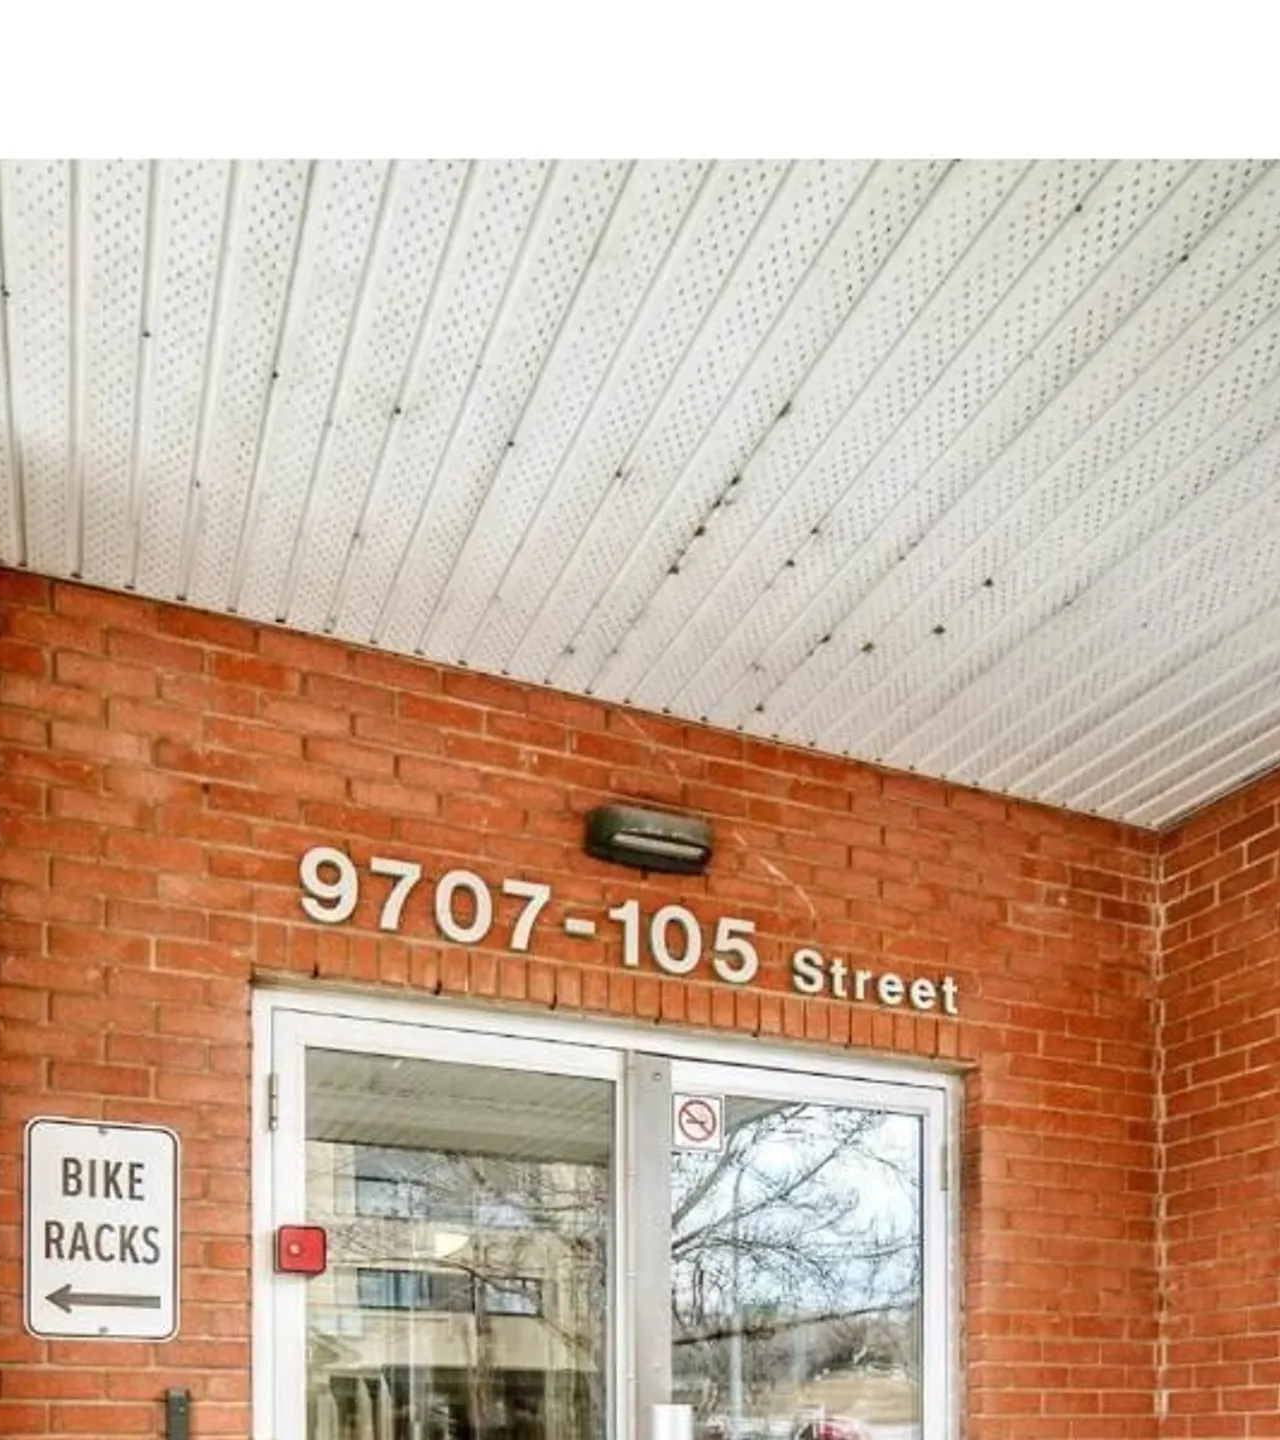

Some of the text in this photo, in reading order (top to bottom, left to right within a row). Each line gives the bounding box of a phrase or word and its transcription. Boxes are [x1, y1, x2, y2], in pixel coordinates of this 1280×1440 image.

[298, 846, 961, 1015] 9707-105 Street
[61, 1157, 145, 1201] BIKE
[44, 1220, 161, 1264] RACKS
